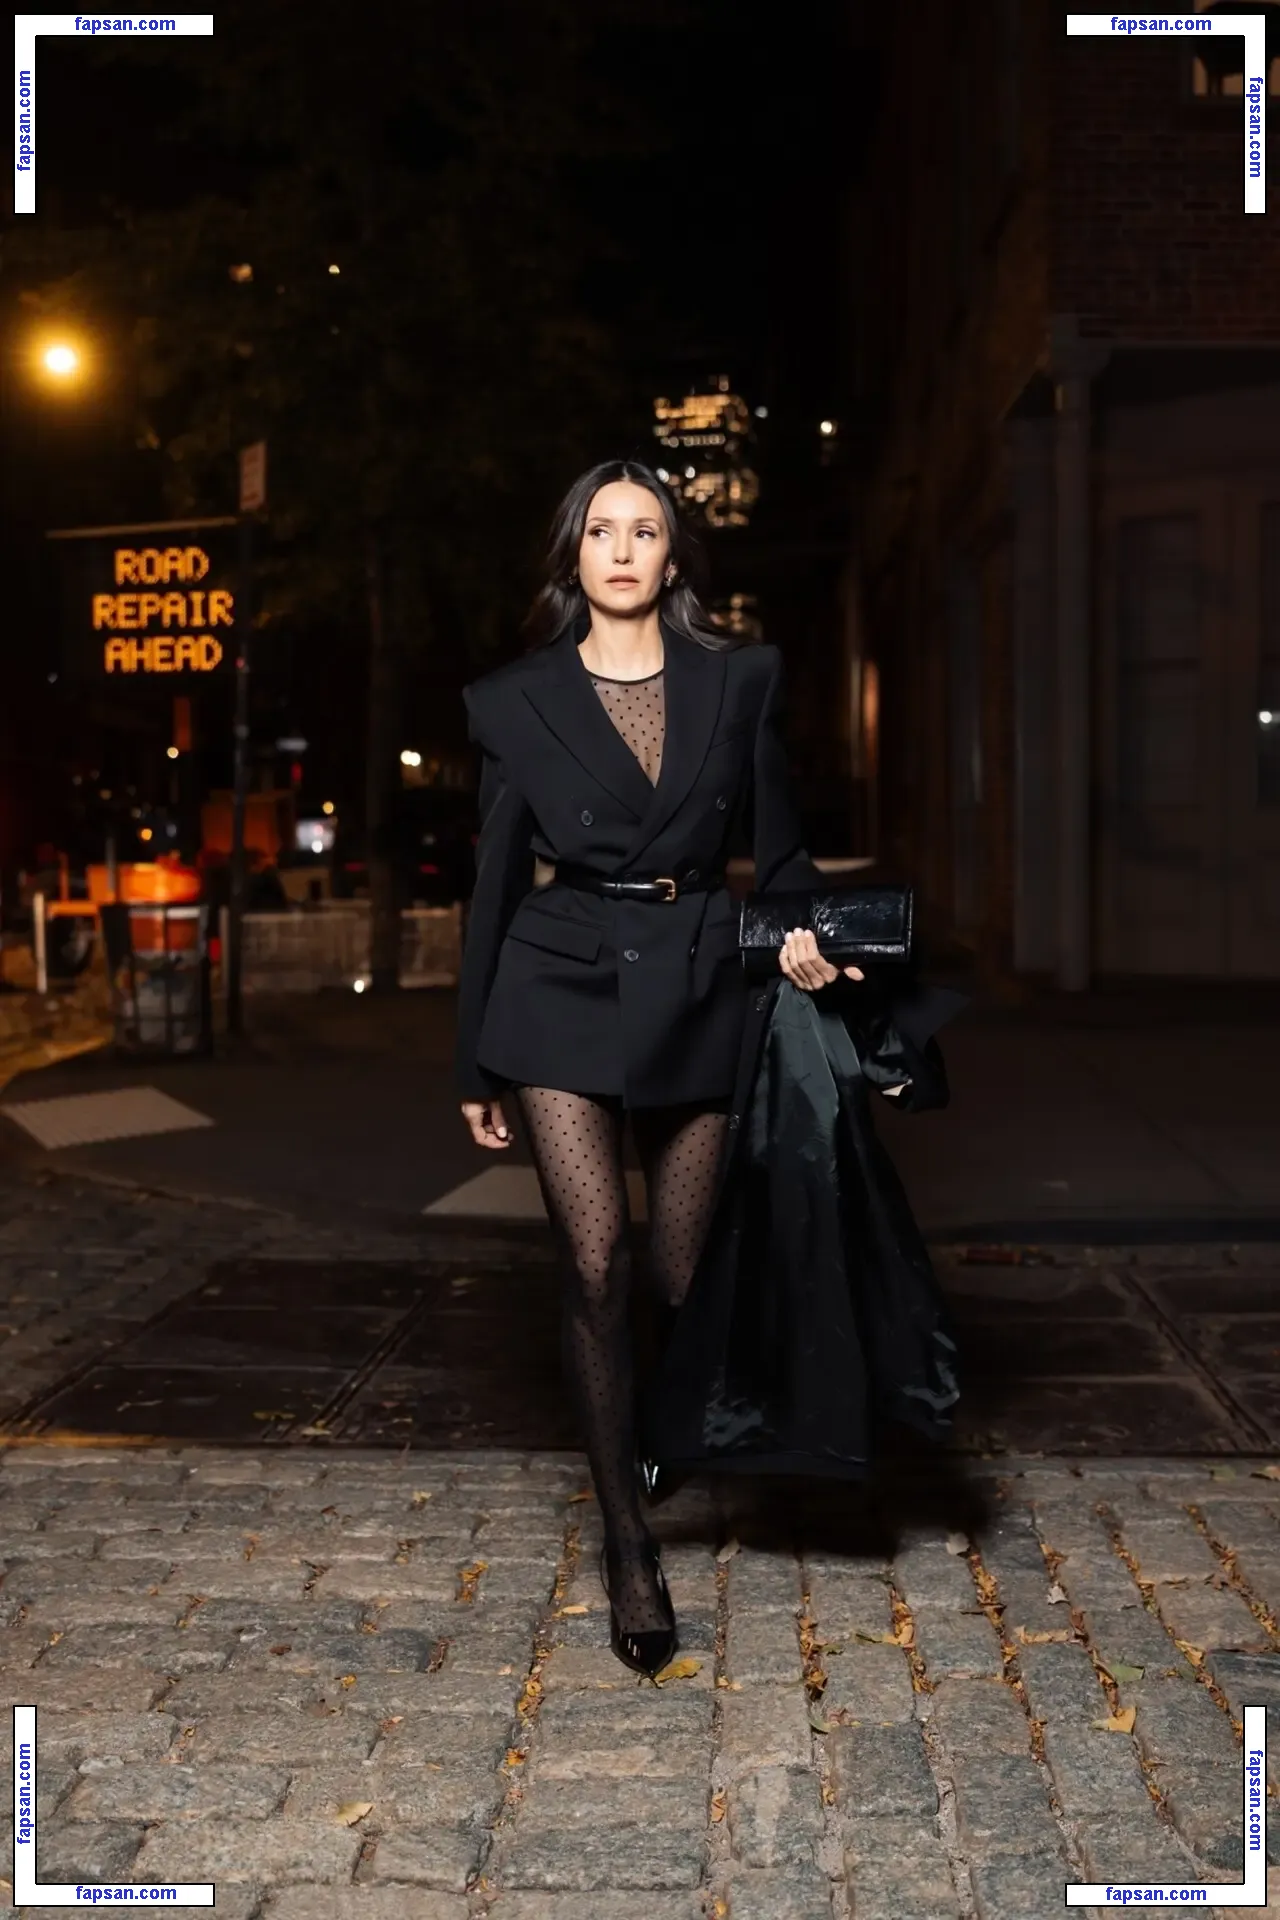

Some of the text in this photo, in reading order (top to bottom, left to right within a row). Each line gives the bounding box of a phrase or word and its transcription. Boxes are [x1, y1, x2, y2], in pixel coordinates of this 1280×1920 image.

[115, 547, 210, 584] ROAD
[92, 590, 234, 629] REPAIR
[104, 635, 223, 672] AHEAD
